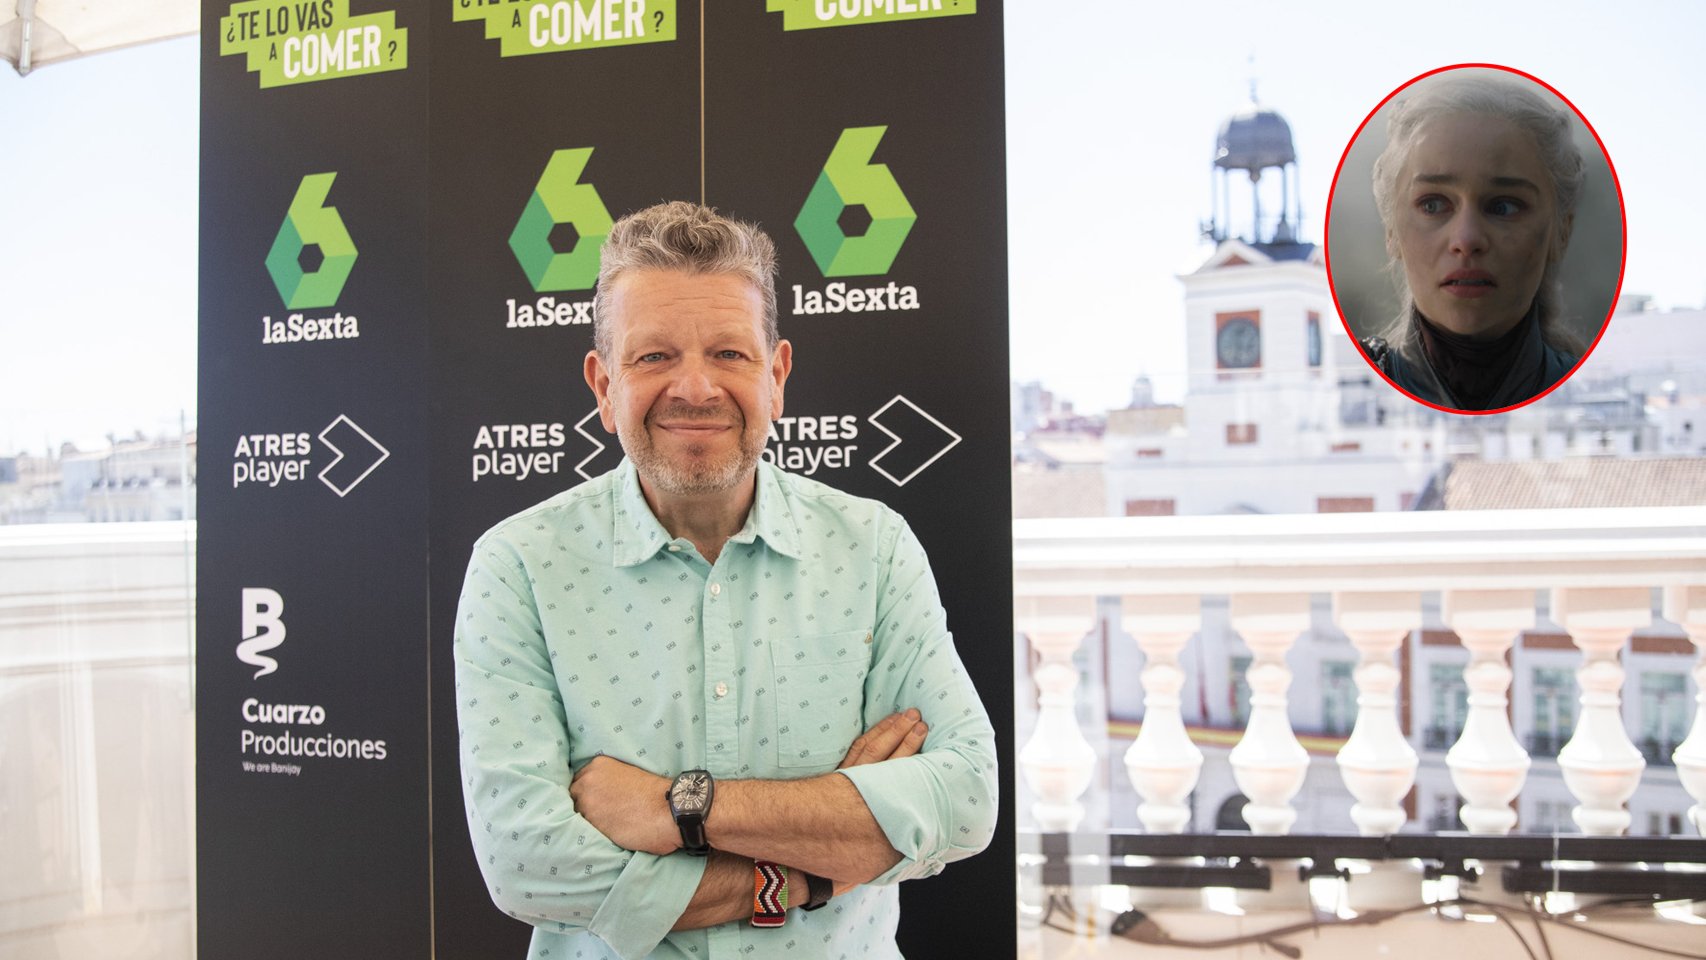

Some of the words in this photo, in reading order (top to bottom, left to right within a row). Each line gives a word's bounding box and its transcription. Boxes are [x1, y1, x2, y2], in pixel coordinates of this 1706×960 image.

[227, 10, 260, 43] ¿TE
[266, 6, 289, 37] LO
[295, 0, 334, 32] VAS
[512, 9, 522, 28] A
[529, 0, 646, 48] COMER
[269, 42, 278, 61] A
[283, 24, 382, 79] COMER
[506, 296, 597, 328] laSex
[792, 281, 920, 315] laSexta
[262, 312, 360, 344] laSexta
[234, 432, 311, 458] ATRES
[473, 423, 566, 449] ATRES
[233, 458, 311, 488] player
[472, 450, 566, 482] player
[241, 697, 326, 726] Cuarzo
[241, 729, 388, 760] Producciones
[242, 761, 256, 773] We
[256, 763, 270, 773] are
[271, 762, 302, 777] Banijay
